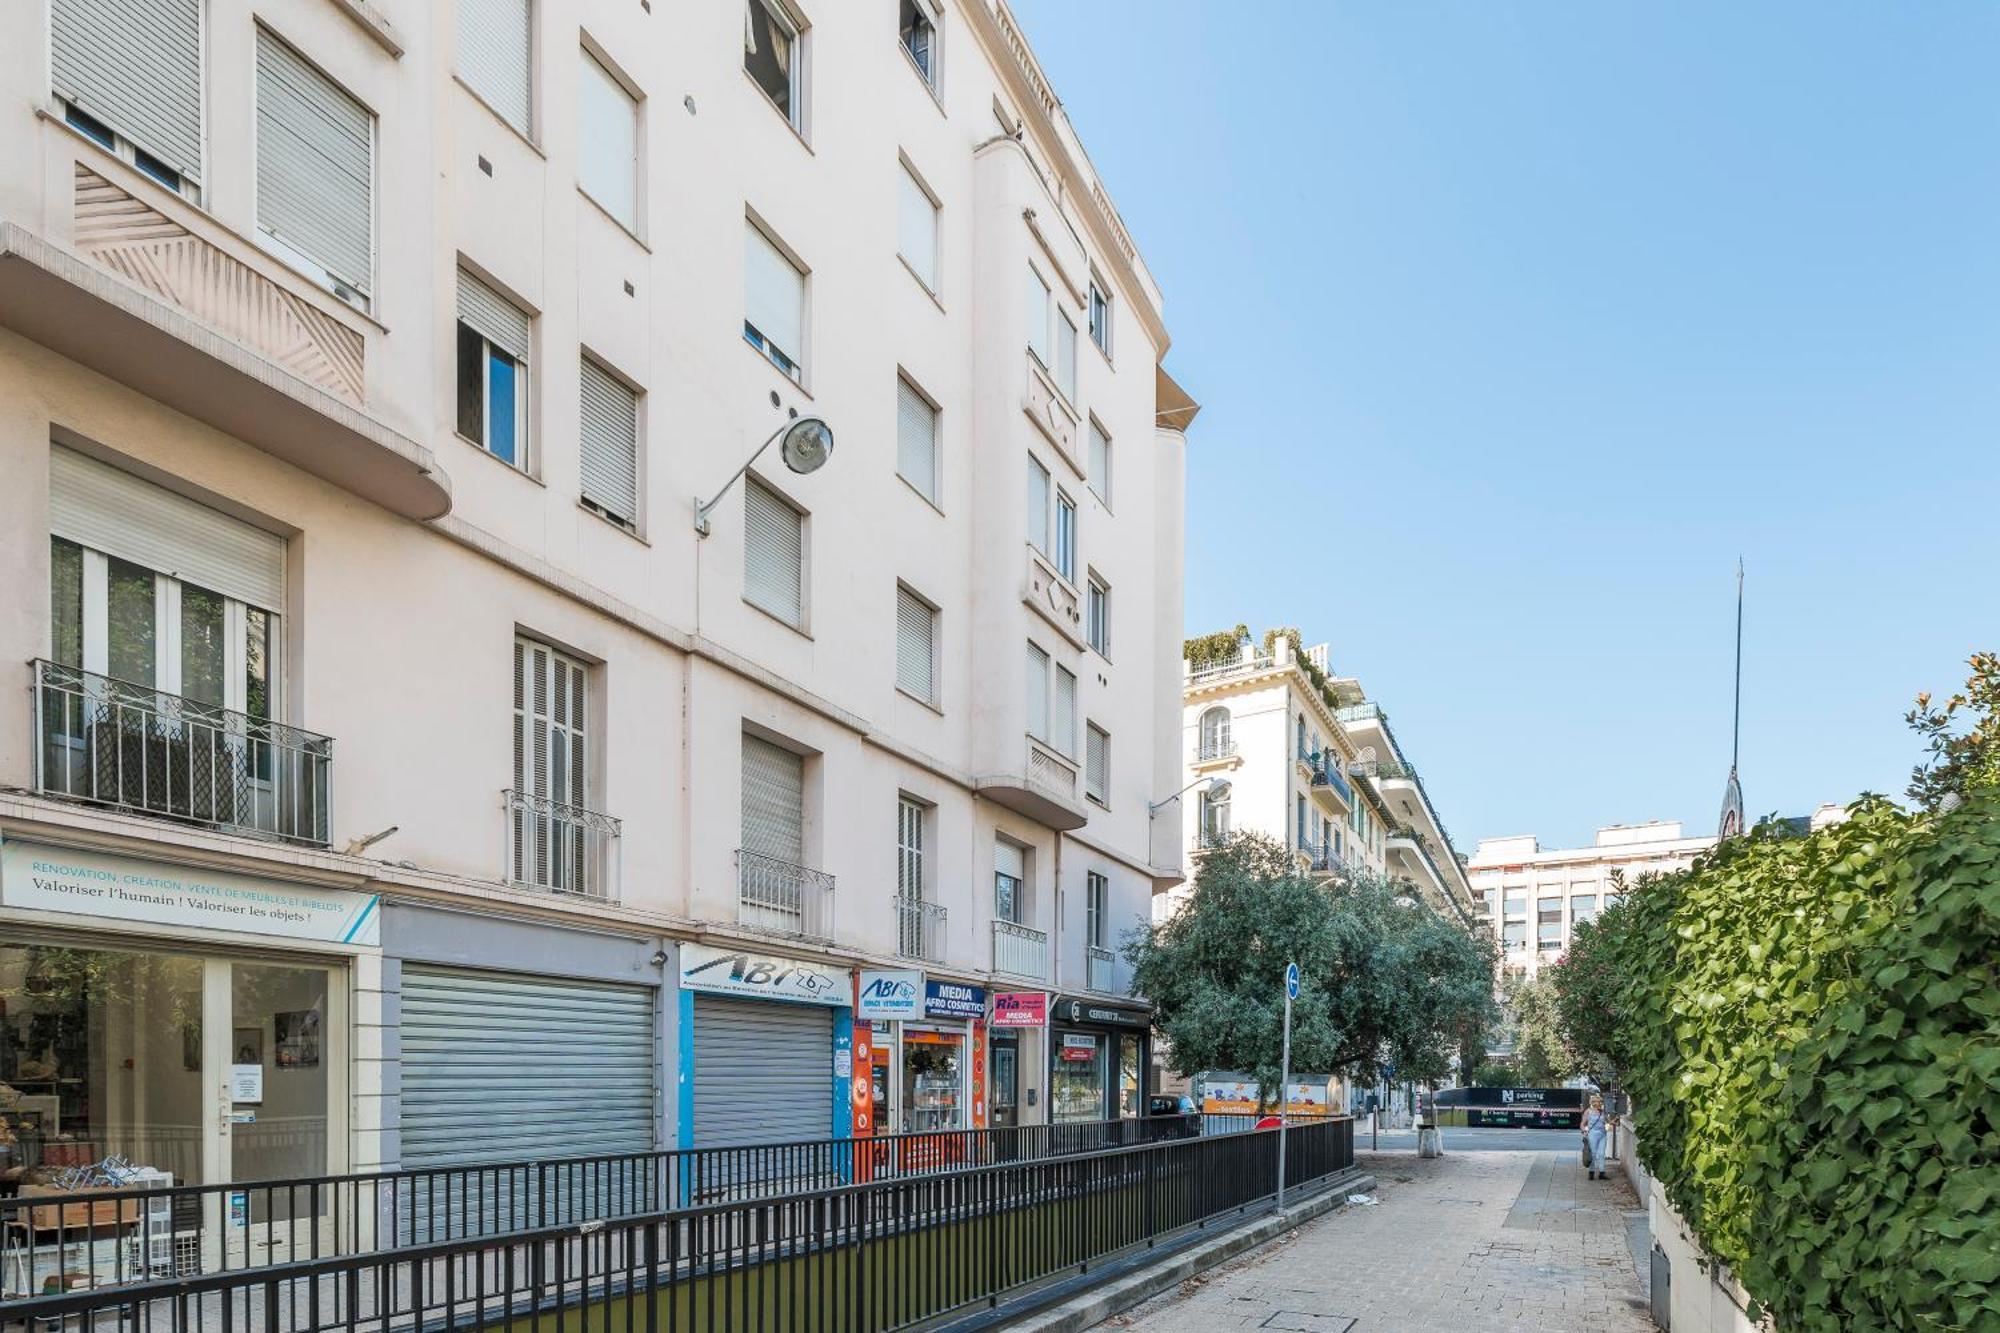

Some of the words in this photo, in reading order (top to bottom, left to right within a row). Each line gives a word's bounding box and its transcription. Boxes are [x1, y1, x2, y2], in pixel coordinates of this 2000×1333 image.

[189, 884, 222, 897] VENTE
[32, 878, 104, 897] Valoriser
[109, 887, 174, 906] l'humain
[187, 897, 245, 914] Valoriser
[250, 905, 266, 917] les
[269, 910, 305, 923] objets
[939, 984, 972, 1000] MEDIA
[926, 997, 945, 1008] AFRO
[947, 999, 985, 1013] COSMETICS
[995, 995, 1020, 1010] Ria
